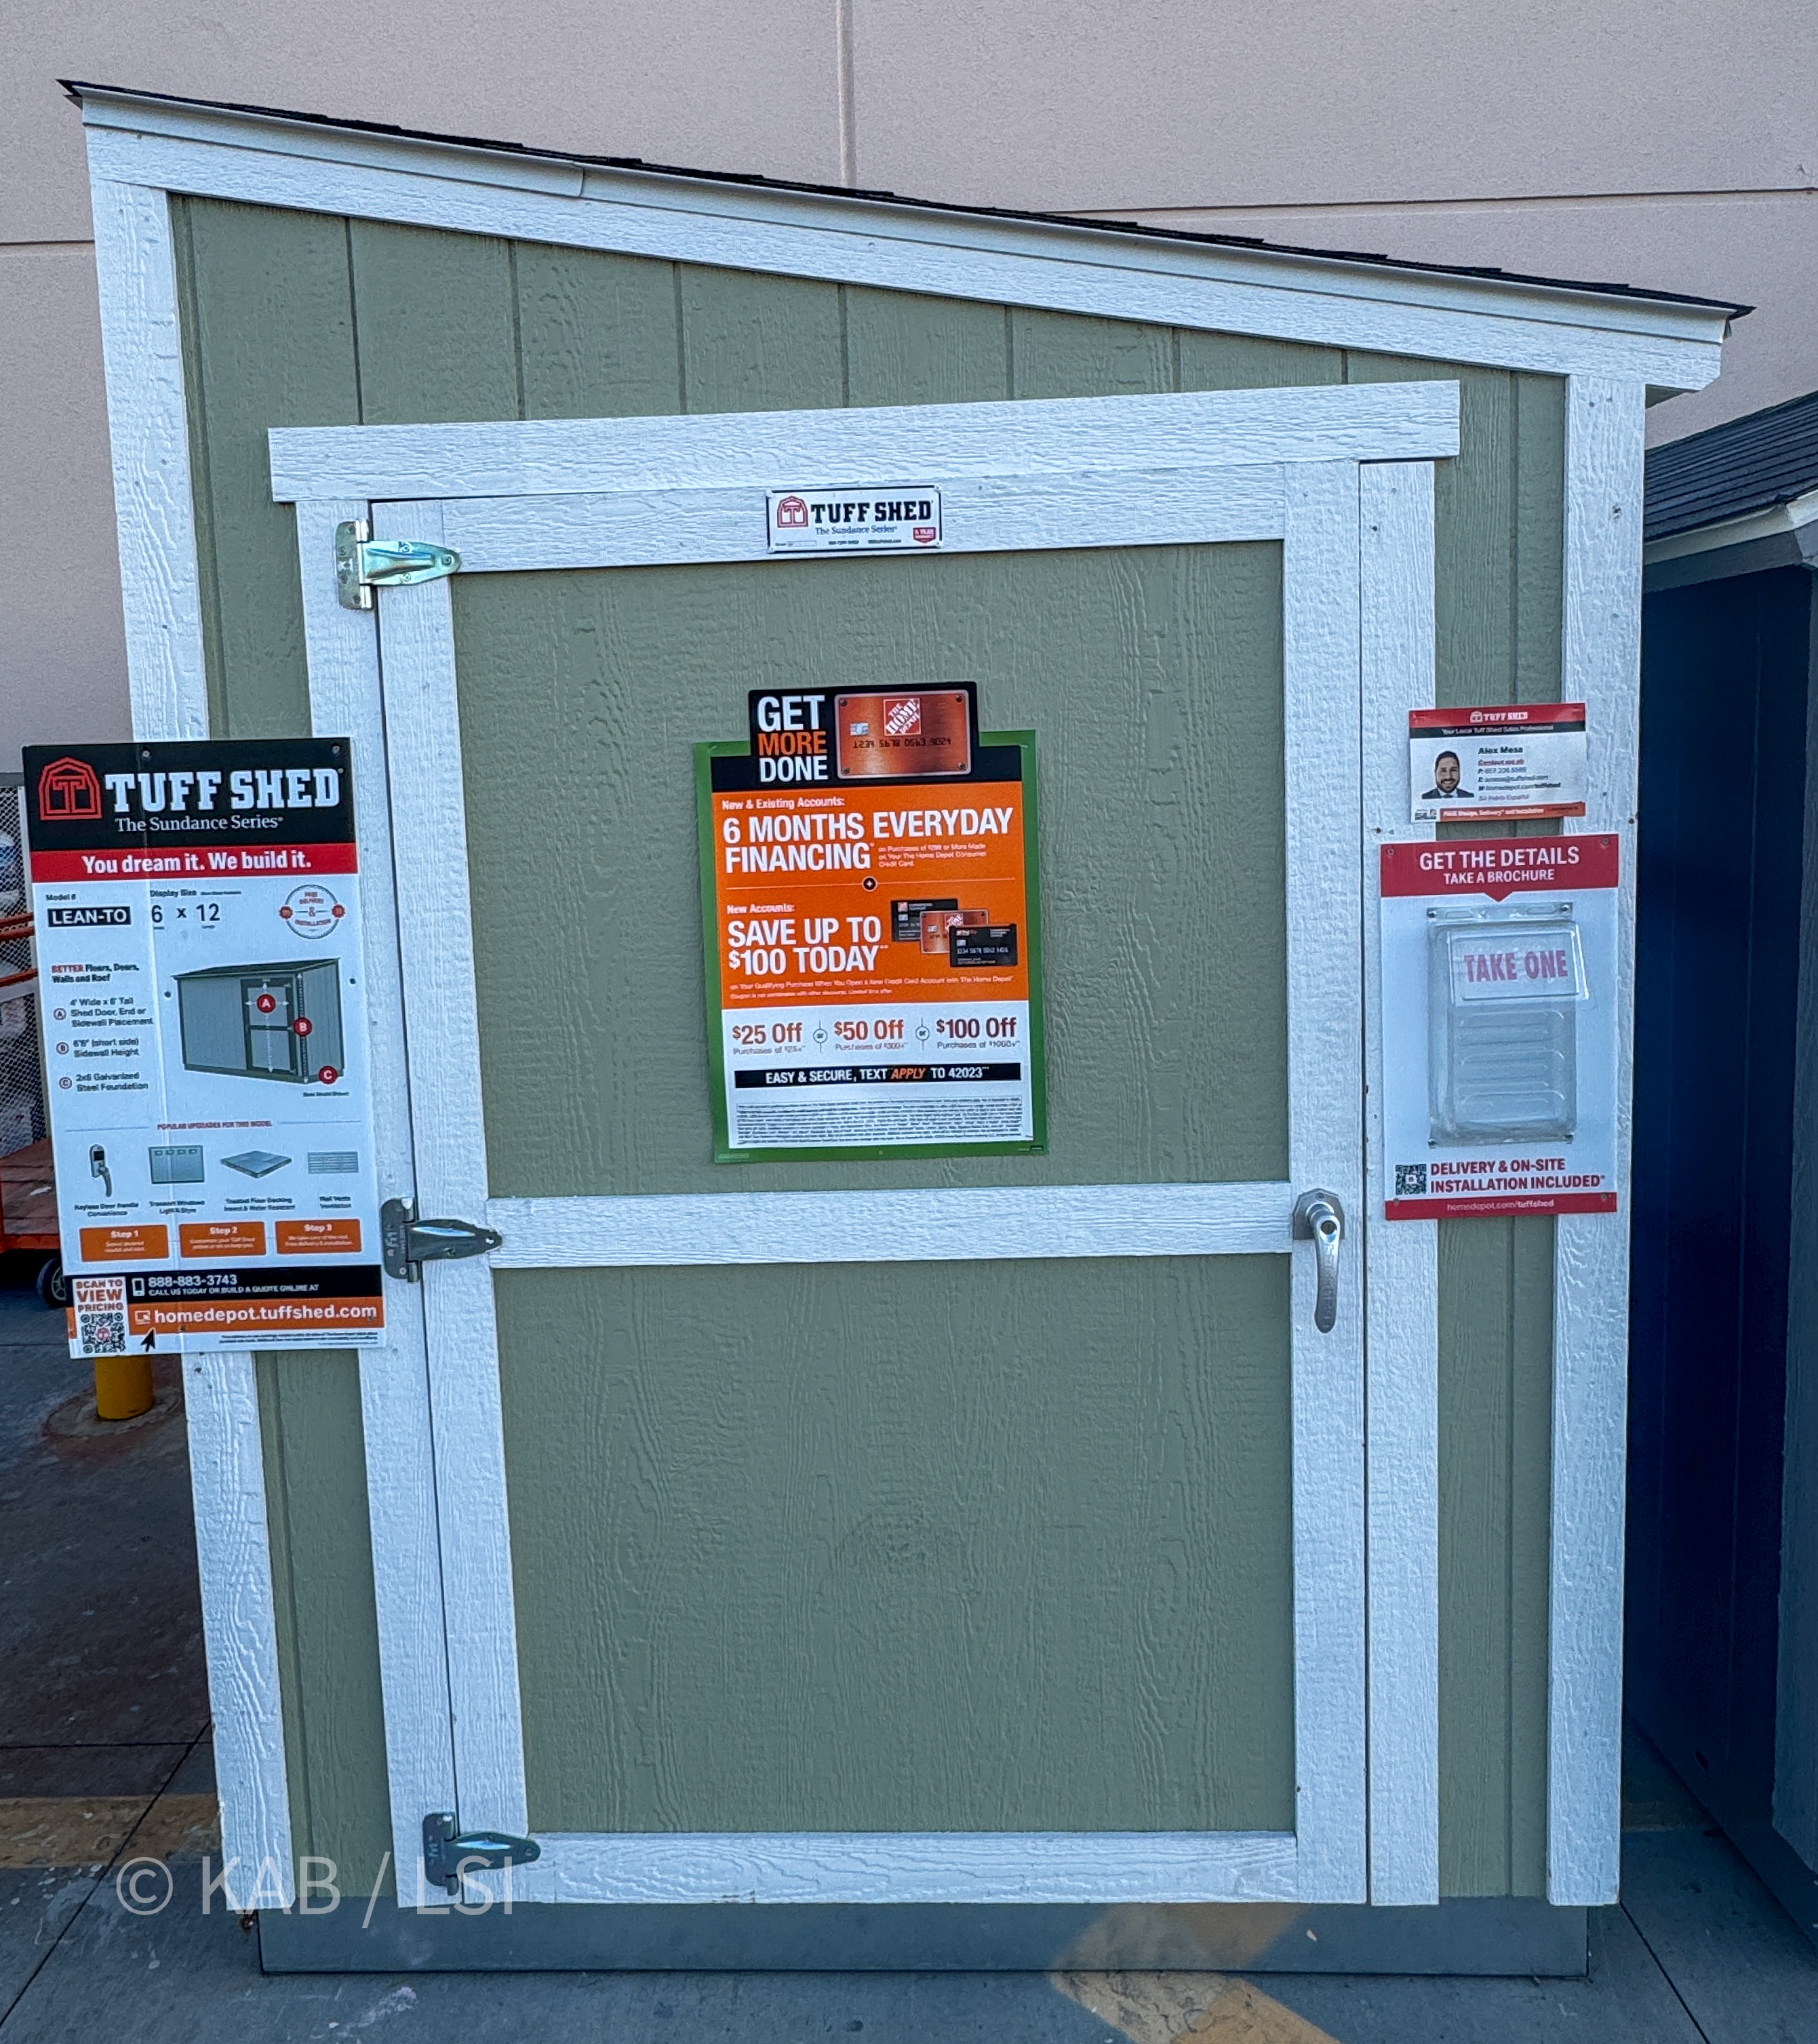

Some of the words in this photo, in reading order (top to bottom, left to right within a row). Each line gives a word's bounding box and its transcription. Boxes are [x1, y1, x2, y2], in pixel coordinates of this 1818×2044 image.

[810, 502, 870, 523] TUFF
[875, 500, 931, 521] SHED
[816, 527, 829, 535] The
[831, 526, 869, 535] Sundance
[757, 694, 825, 732] GET
[758, 731, 828, 755] MORE
[1478, 746, 1498, 755] Alex
[759, 755, 829, 782] DONE
[105, 769, 222, 814] TUFF
[230, 768, 340, 811] SHED
[722, 801, 743, 810] New
[746, 799, 753, 809] &
[756, 798, 795, 809] Existing
[797, 796, 845, 808] Accounts:
[115, 818, 146, 833] The
[149, 816, 228, 832] Sundance
[723, 818, 740, 843] 6
[749, 812, 865, 843] MONTHS
[873, 807, 1013, 839] EVERYDAY
[82, 854, 118, 875] You
[121, 852, 182, 873] dream
[185, 852, 204, 872] it.
[208, 851, 239, 871] We
[242, 849, 288, 870] build
[291, 849, 311, 869] it.
[1419, 851, 1456, 870] GET
[1459, 849, 1496, 869] THE
[1501, 846, 1580, 867] DETAILS
[1444, 872, 1474, 885] TAKE
[1476, 872, 1485, 883] A
[1487, 869, 1555, 883] BROCHURE
[150, 889, 178, 898] Display
[52, 908, 127, 925] LEAN-TO
[151, 904, 163, 923] 6
[176, 907, 186, 919] x
[196, 902, 220, 922] 12
[726, 904, 747, 914] New
[749, 903, 795, 913] Accounts:
[728, 918, 797, 948] SAVE
[804, 917, 839, 944] UP
[846, 916, 882, 943] TO
[52, 964, 84, 974] BETTER
[728, 948, 787, 976] $100
[1463, 952, 1518, 983] TAKE
[1525, 950, 1568, 980] ONE
[75, 974, 90, 982] and
[79, 998, 101, 1006] Wide
[262, 998, 271, 1007] A
[119, 1007, 135, 1016] End
[299, 1023, 307, 1032] B
[732, 1024, 766, 1045] $25
[772, 1022, 803, 1043] Off
[833, 1020, 869, 1041] $50
[873, 1018, 904, 1041] Off
[936, 1018, 981, 1039] $100
[985, 1016, 1017, 1038] Off
[323, 1070, 333, 1080] C
[766, 1071, 795, 1084] EASY
[797, 1071, 807, 1083] &
[809, 1069, 856, 1083] SECURE,
[859, 1068, 888, 1081] TEXT
[890, 1067, 926, 1080] APPLY
[930, 1067, 945, 1079] TO
[1430, 1161, 1496, 1176] DELIVERY
[1498, 1160, 1509, 1173] &
[1510, 1157, 1566, 1173] ON-SITE
[1430, 1177, 1528, 1194] INSTALLATION
[1447, 1199, 1554, 1211] homedepot.com/tuffshed
[111, 1230, 132, 1239] Step
[134, 1229, 138, 1237] 1
[210, 1227, 231, 1235] Step
[304, 1224, 325, 1233] Step
[76, 1280, 106, 1289] SCAN
[108, 1279, 123, 1287] TO
[148, 1274, 237, 1287] 888-883-3743
[221, 1285, 243, 1294] BUILD
[309, 1283, 319, 1291] AT
[77, 1288, 123, 1302] VIEW
[78, 1302, 124, 1312] PRICING
[155, 1304, 377, 1323] homedepot.tuffshed.com
